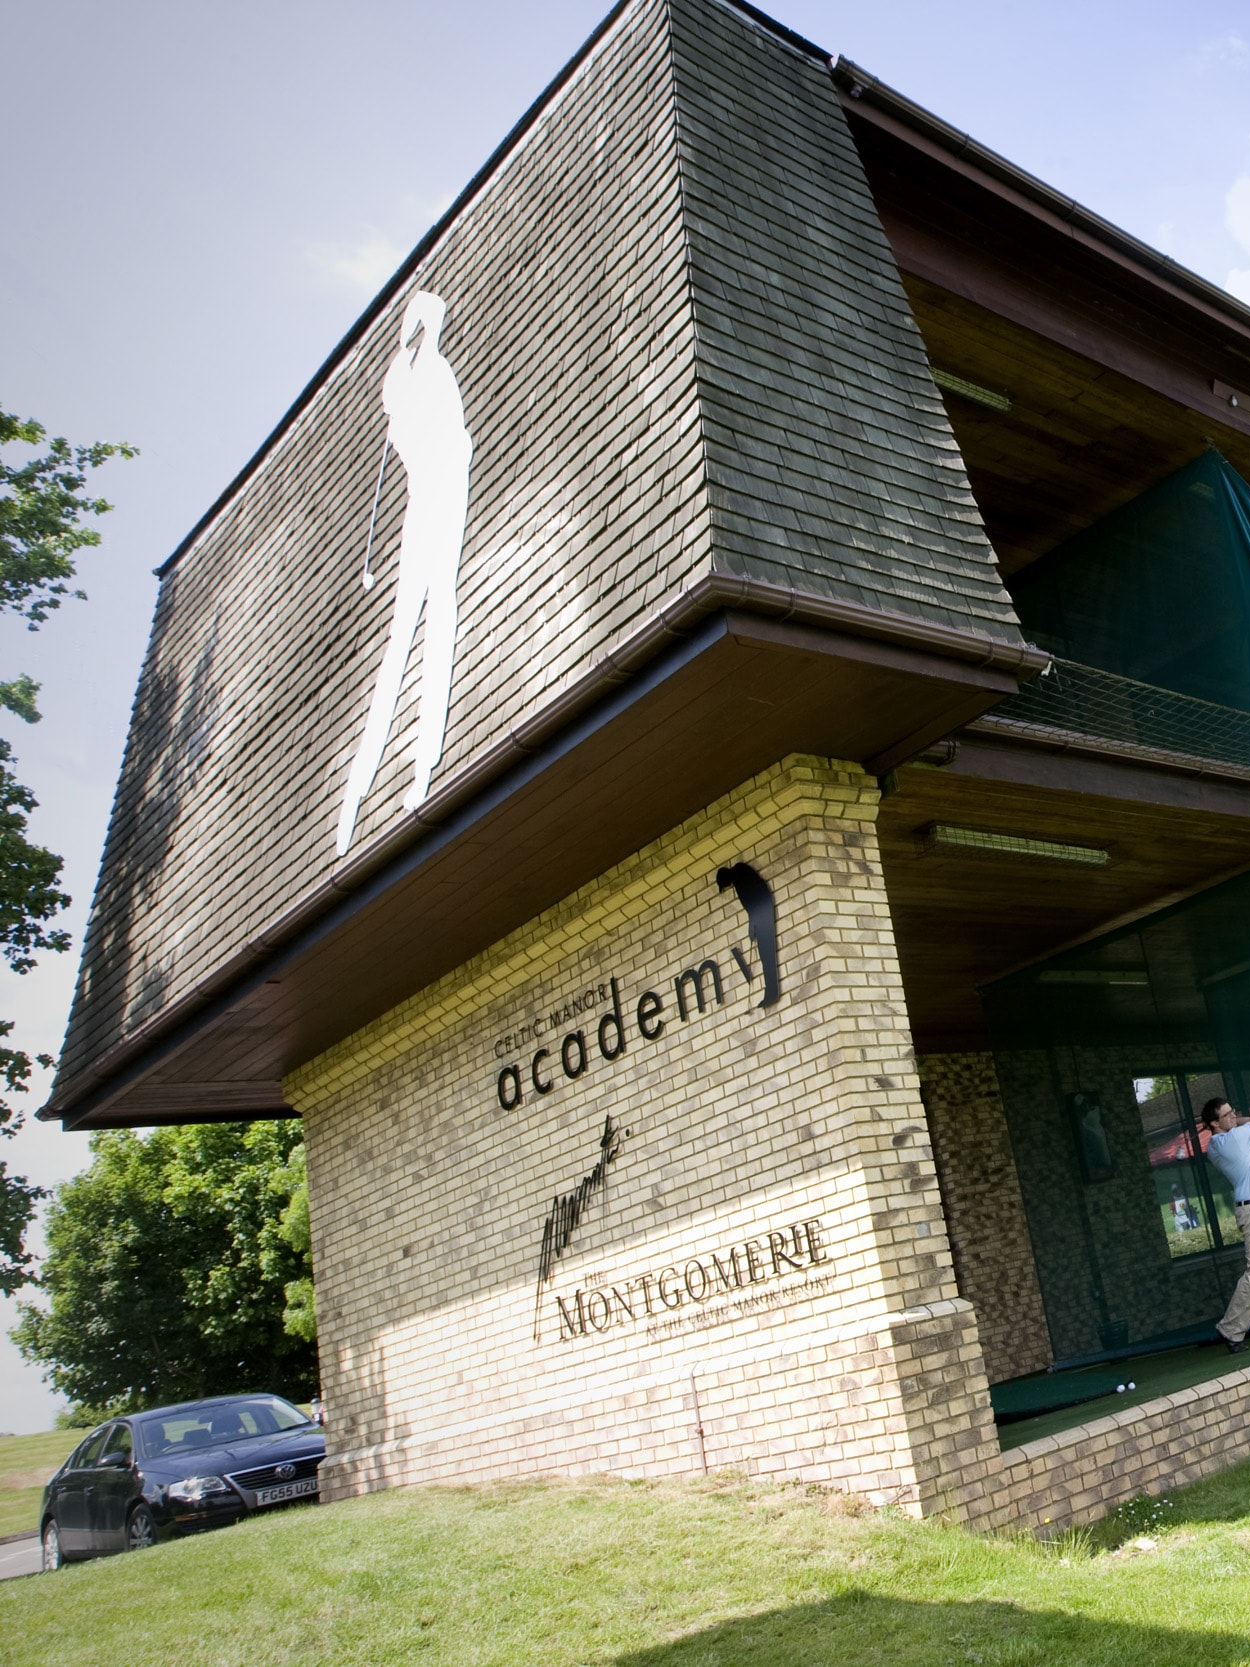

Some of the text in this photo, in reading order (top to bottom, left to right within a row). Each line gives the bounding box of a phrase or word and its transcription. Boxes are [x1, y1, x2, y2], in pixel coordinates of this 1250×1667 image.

[495, 984, 608, 1058] CELTIC MANOR
[498, 862, 781, 1111] academy
[555, 1219, 828, 1341] MONTGOMERIE
[688, 1304, 730, 1324] CELTIC
[733, 1289, 778, 1310] MANOR
[782, 1273, 831, 1297] RESORT
[261, 1486, 293, 1502] FG55
